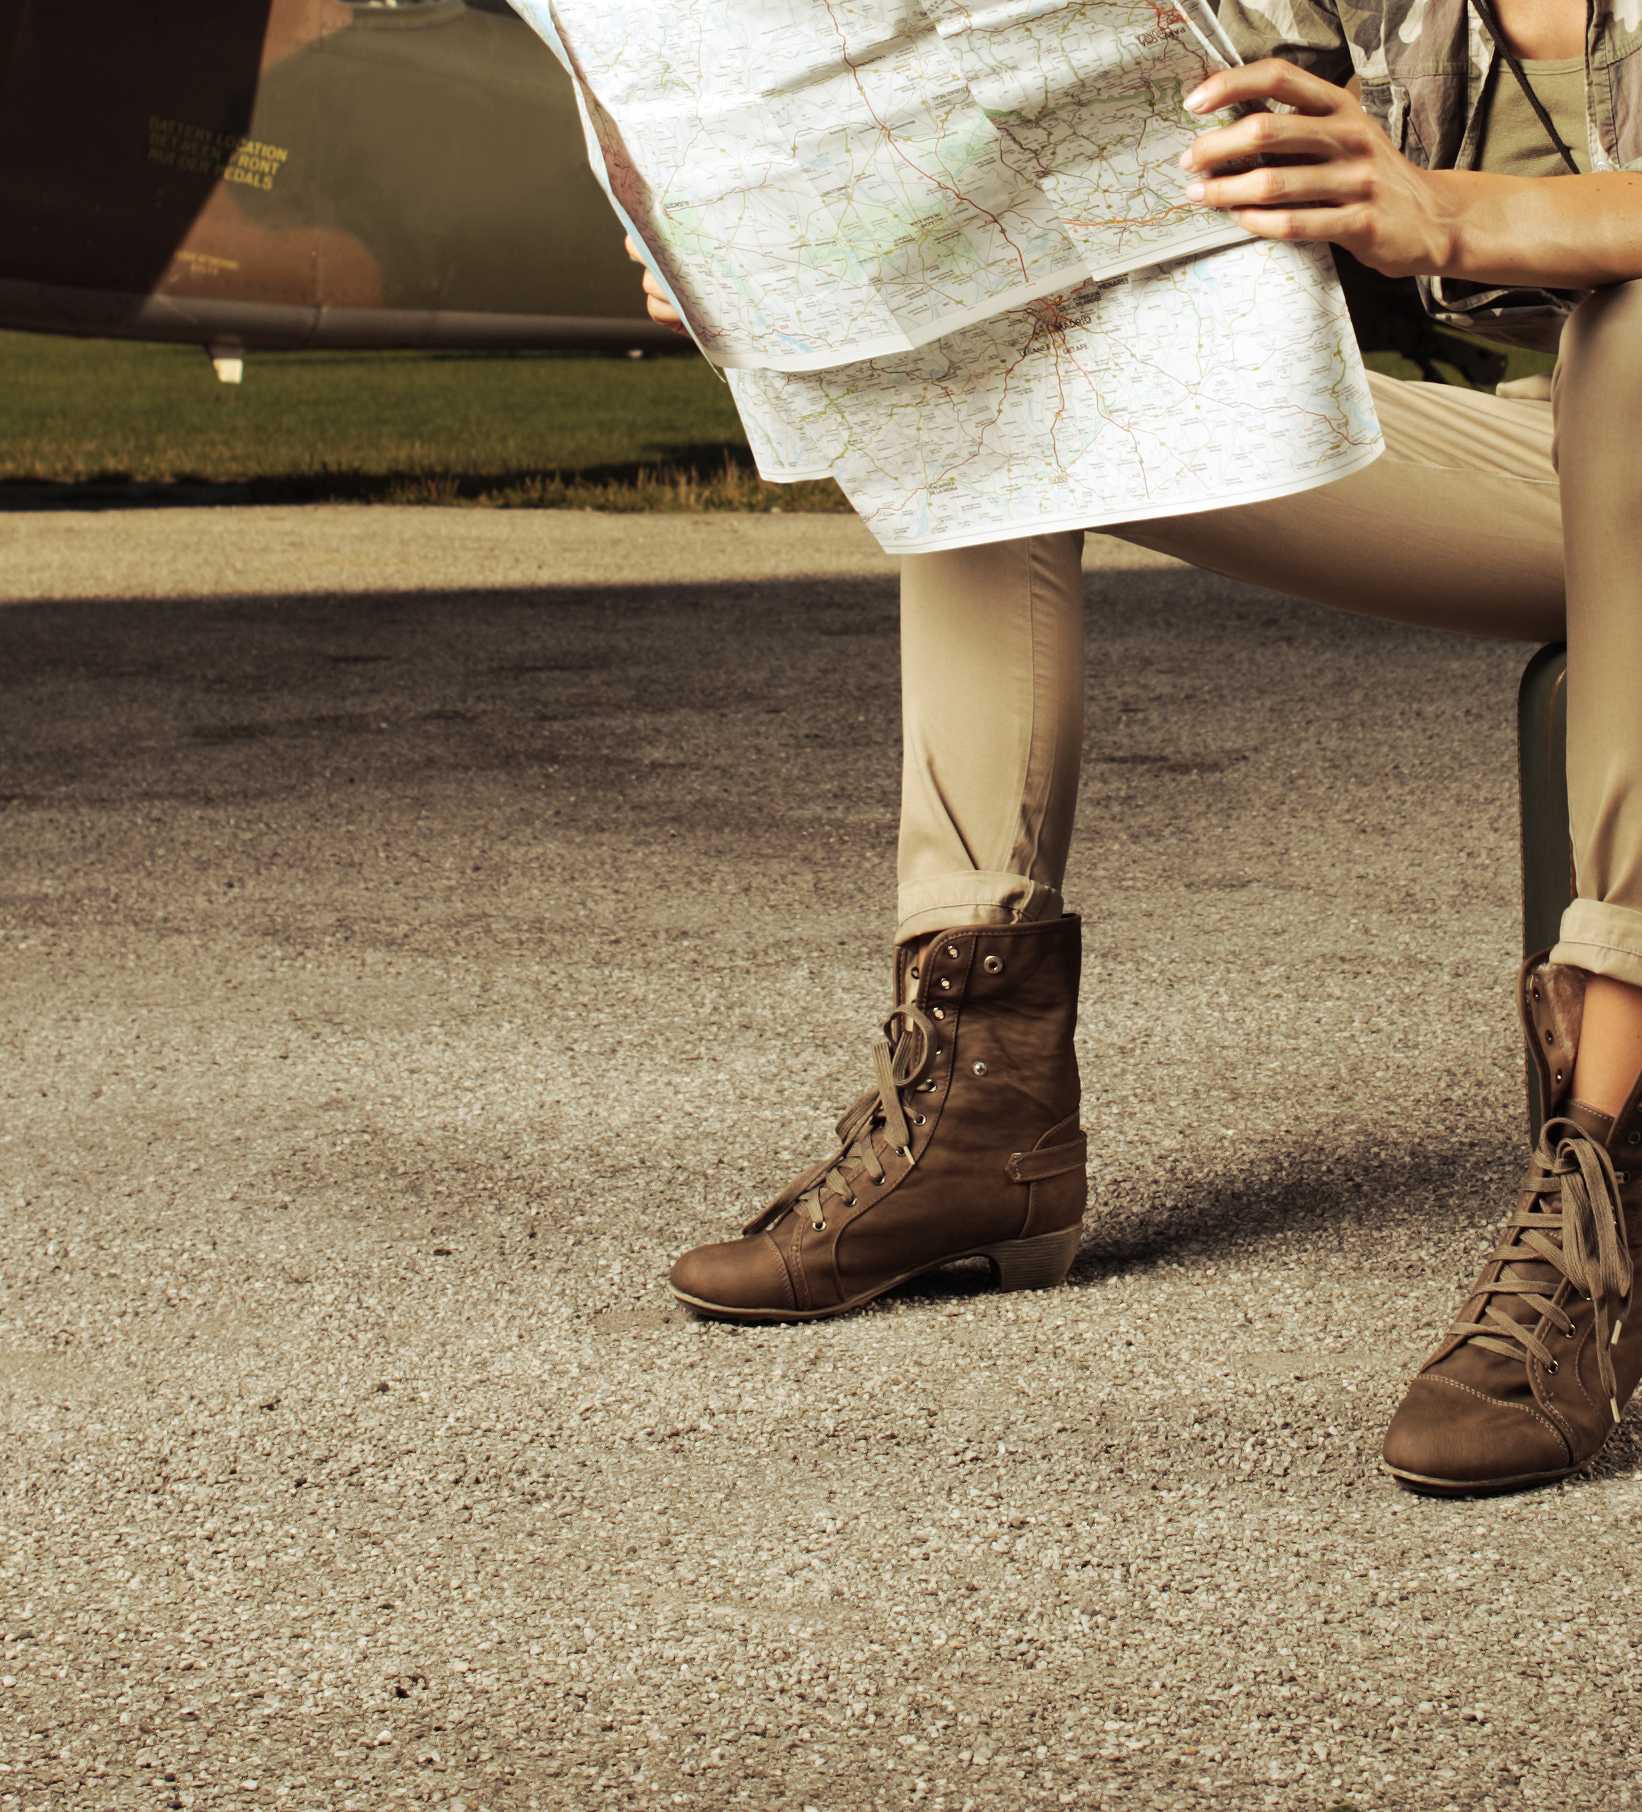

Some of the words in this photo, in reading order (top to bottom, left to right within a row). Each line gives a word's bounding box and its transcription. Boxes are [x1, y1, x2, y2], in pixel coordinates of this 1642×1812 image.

[149, 115, 213, 143] BATTERY
[216, 132, 288, 162] LOCATION
[149, 131, 223, 161] BETWEEN
[228, 152, 279, 175] FRONT
[148, 146, 211, 174] RUDDER
[214, 164, 273, 190] PEDALS
[1057, 314, 1091, 330] MADRID
